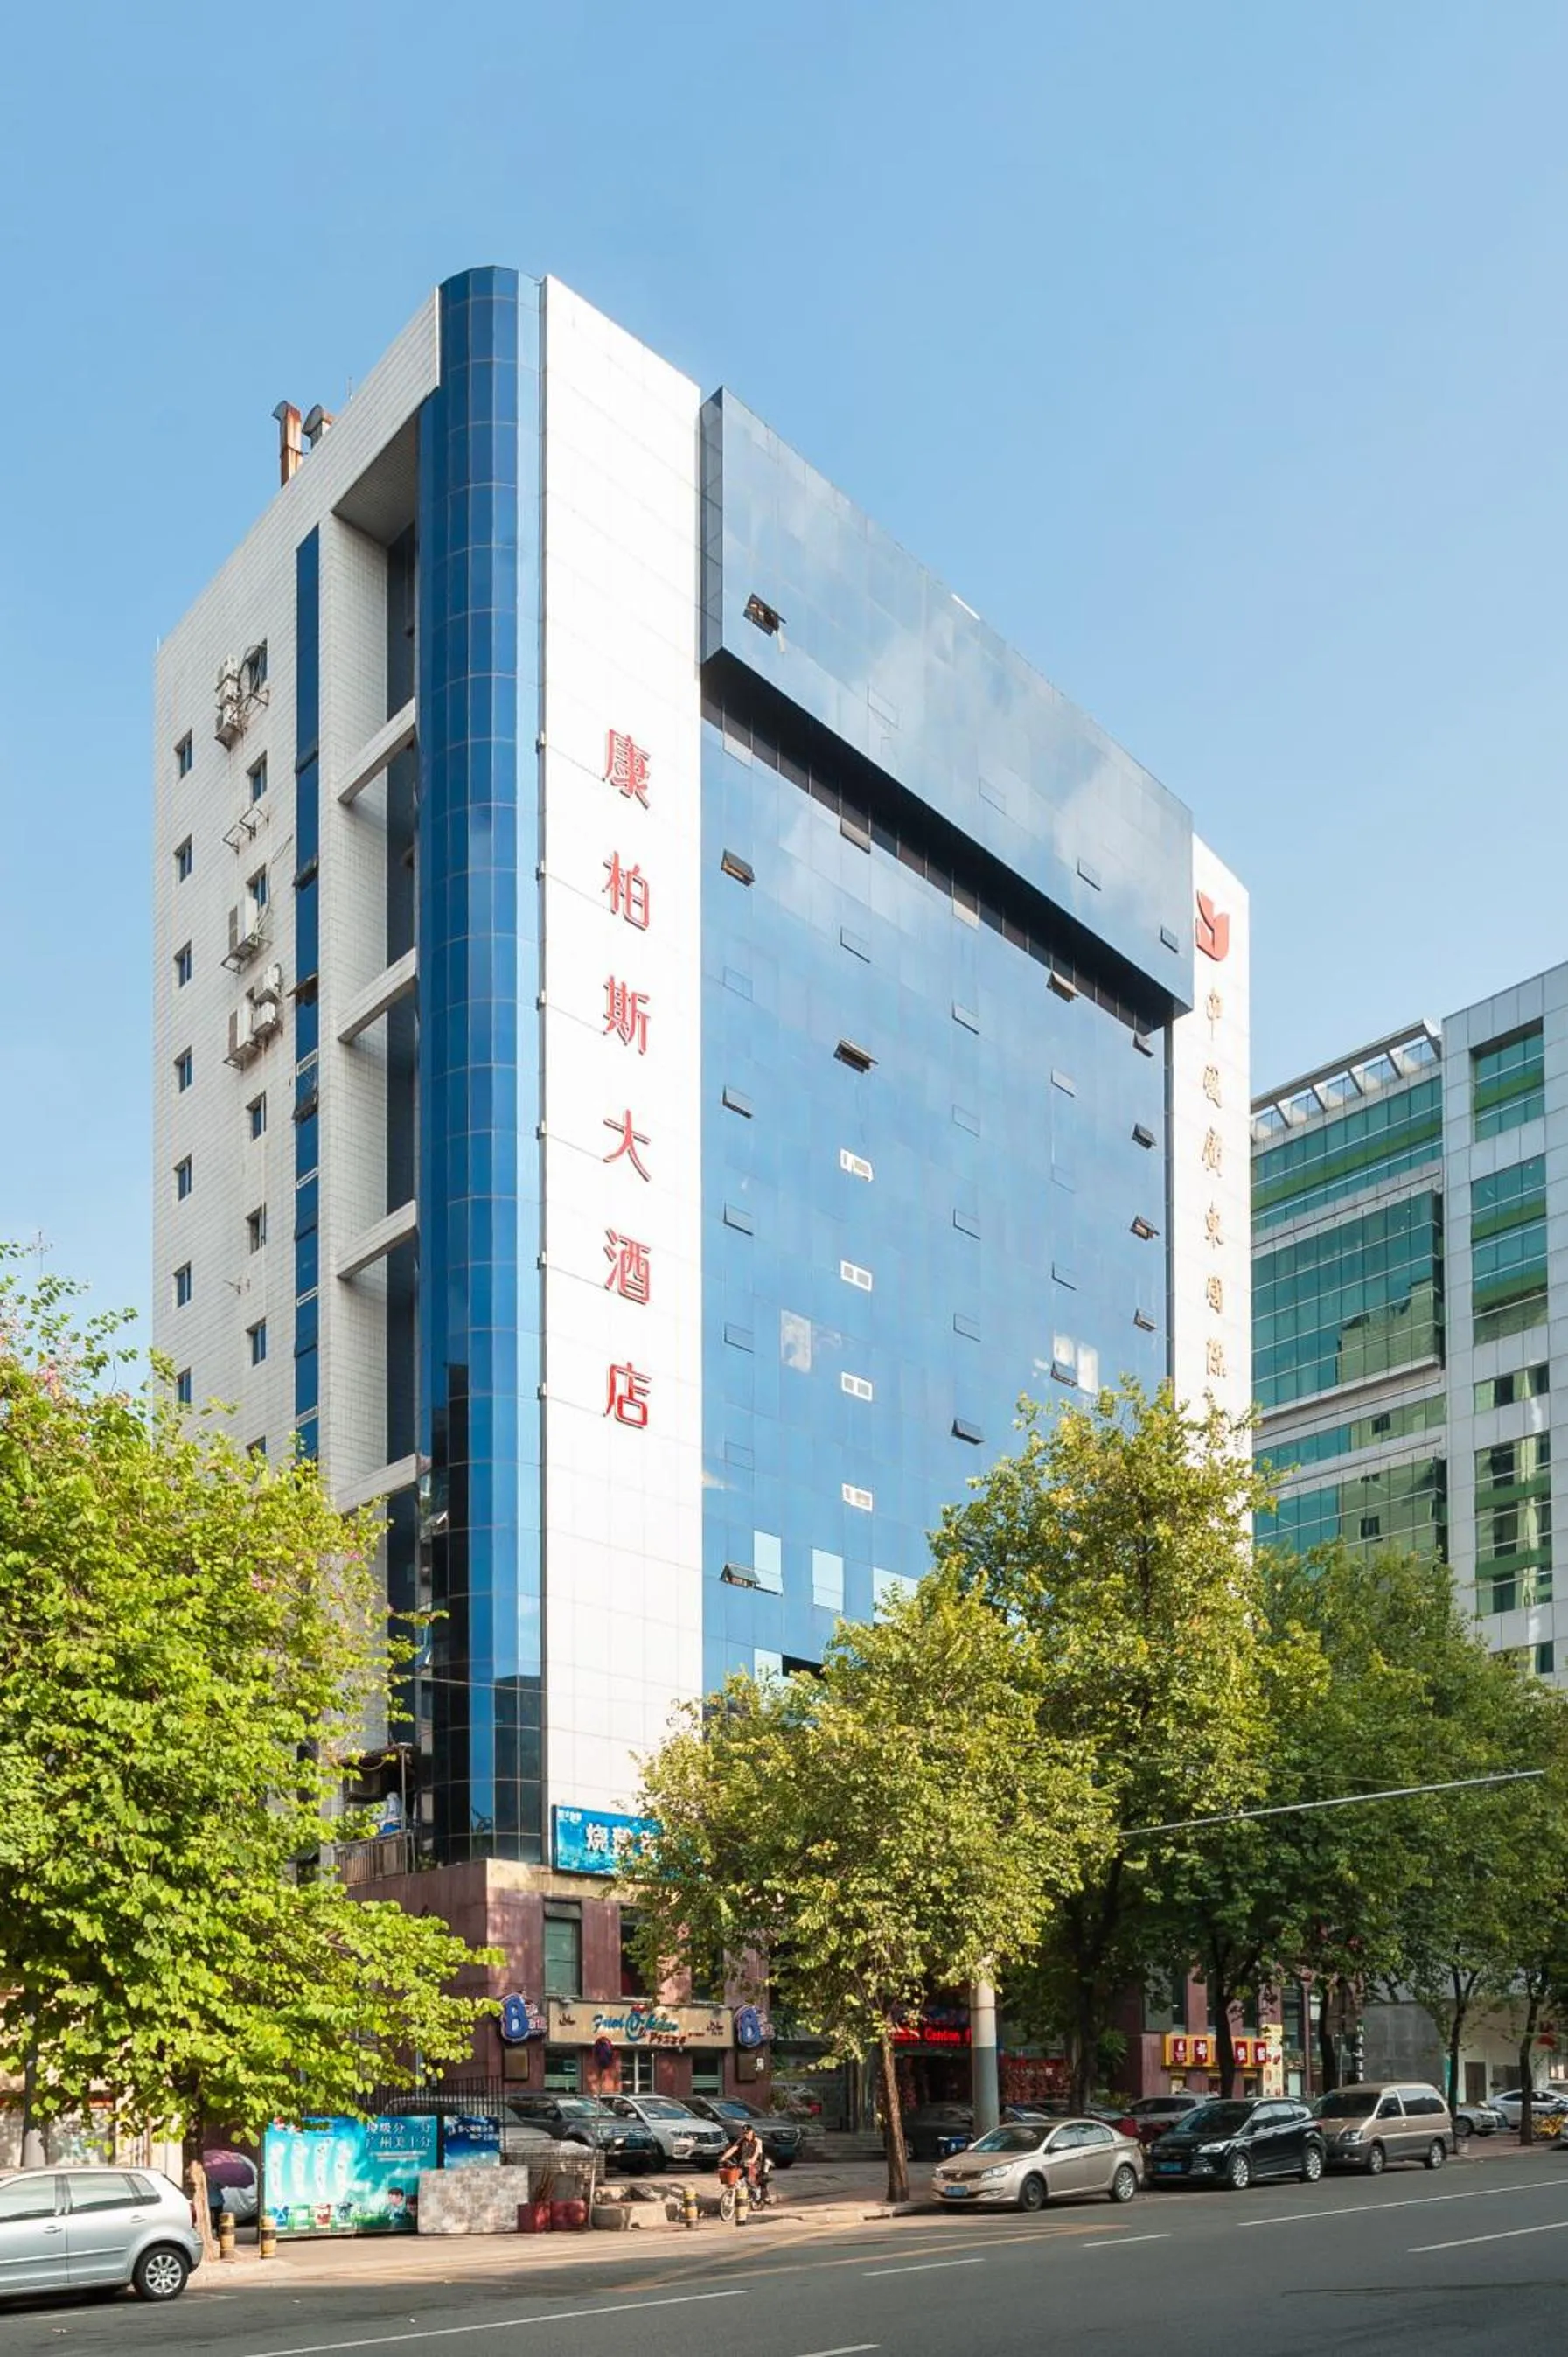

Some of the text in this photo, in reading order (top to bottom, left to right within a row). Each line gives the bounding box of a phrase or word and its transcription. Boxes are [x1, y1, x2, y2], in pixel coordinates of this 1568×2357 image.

[602, 729, 652, 1430] 康柏斯大酒店
